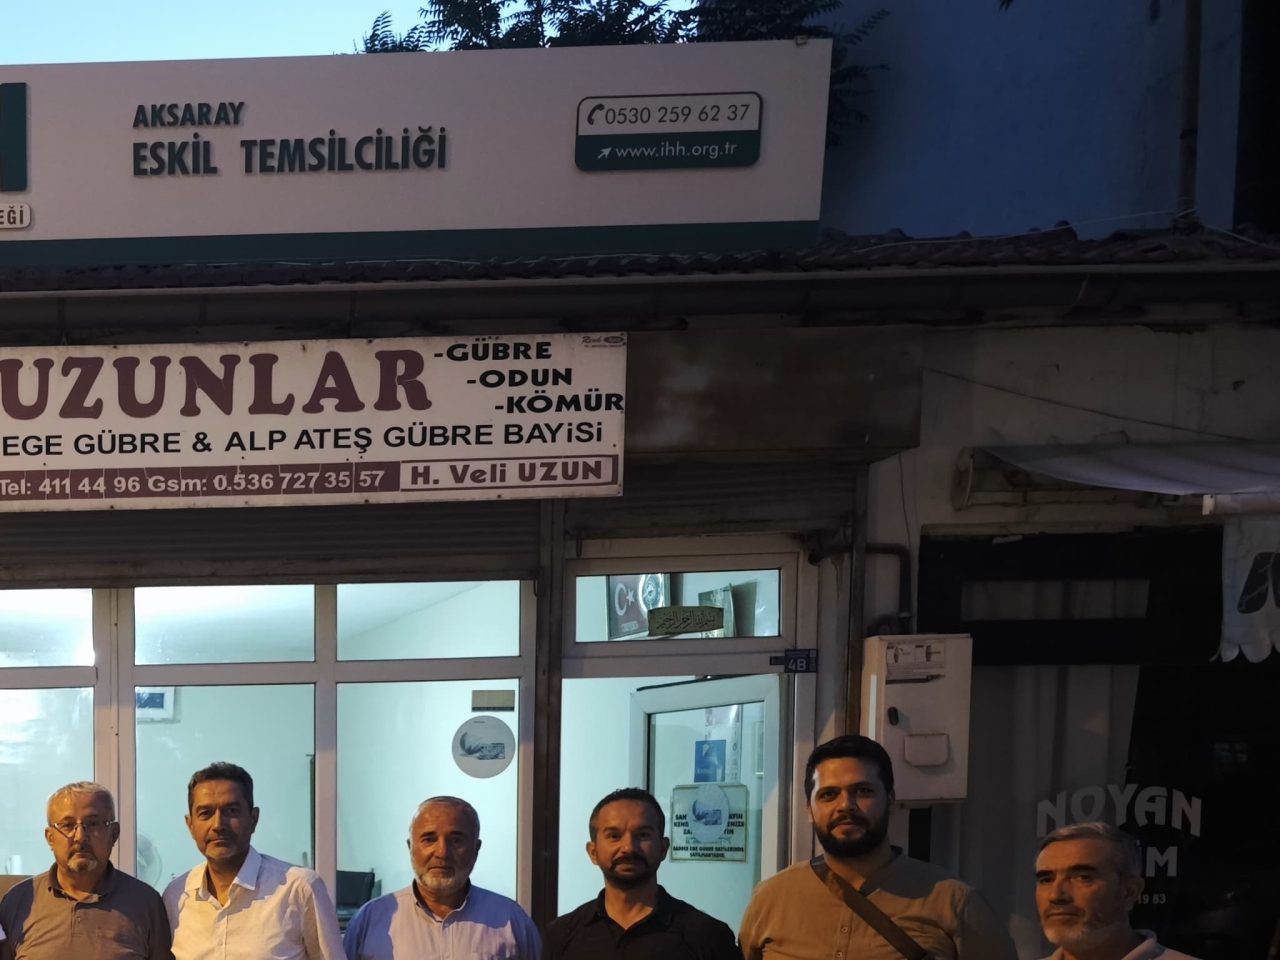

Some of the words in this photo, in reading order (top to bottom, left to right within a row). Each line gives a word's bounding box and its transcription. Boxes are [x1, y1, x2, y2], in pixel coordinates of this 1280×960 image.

[132, 101, 244, 128] AKSARAY
[605, 104, 652, 125] 0530
[657, 104, 694, 123] 259
[697, 104, 721, 123] 62
[726, 103, 751, 122] 37
[133, 131, 218, 177] ESKİL
[240, 125, 448, 174] TEMSİLCİLİĞİ
[615, 141, 737, 160] www.ihh.org.tr
[2, 435, 63, 457] EGE
[73, 427, 182, 456] GÜBRE
[193, 431, 213, 453] &
[225, 430, 288, 452] ALP
[293, 428, 373, 457] ATEŞ
[383, 422, 494, 449] GÜBRE
[37, 475, 72, 494] 411
[78, 474, 106, 494] 44
[113, 474, 141, 493] 96
[147, 474, 208, 493] Gsm:
[280, 471, 318, 490] 727
[324, 470, 351, 489] 35
[359, 469, 386, 488] 57
[411, 466, 440, 485] H.
[448, 462, 507, 484] Veli
[516, 460, 604, 482] UZUN
[788, 658, 807, 671] 4B
[1036, 783, 1202, 838] NOYAN
